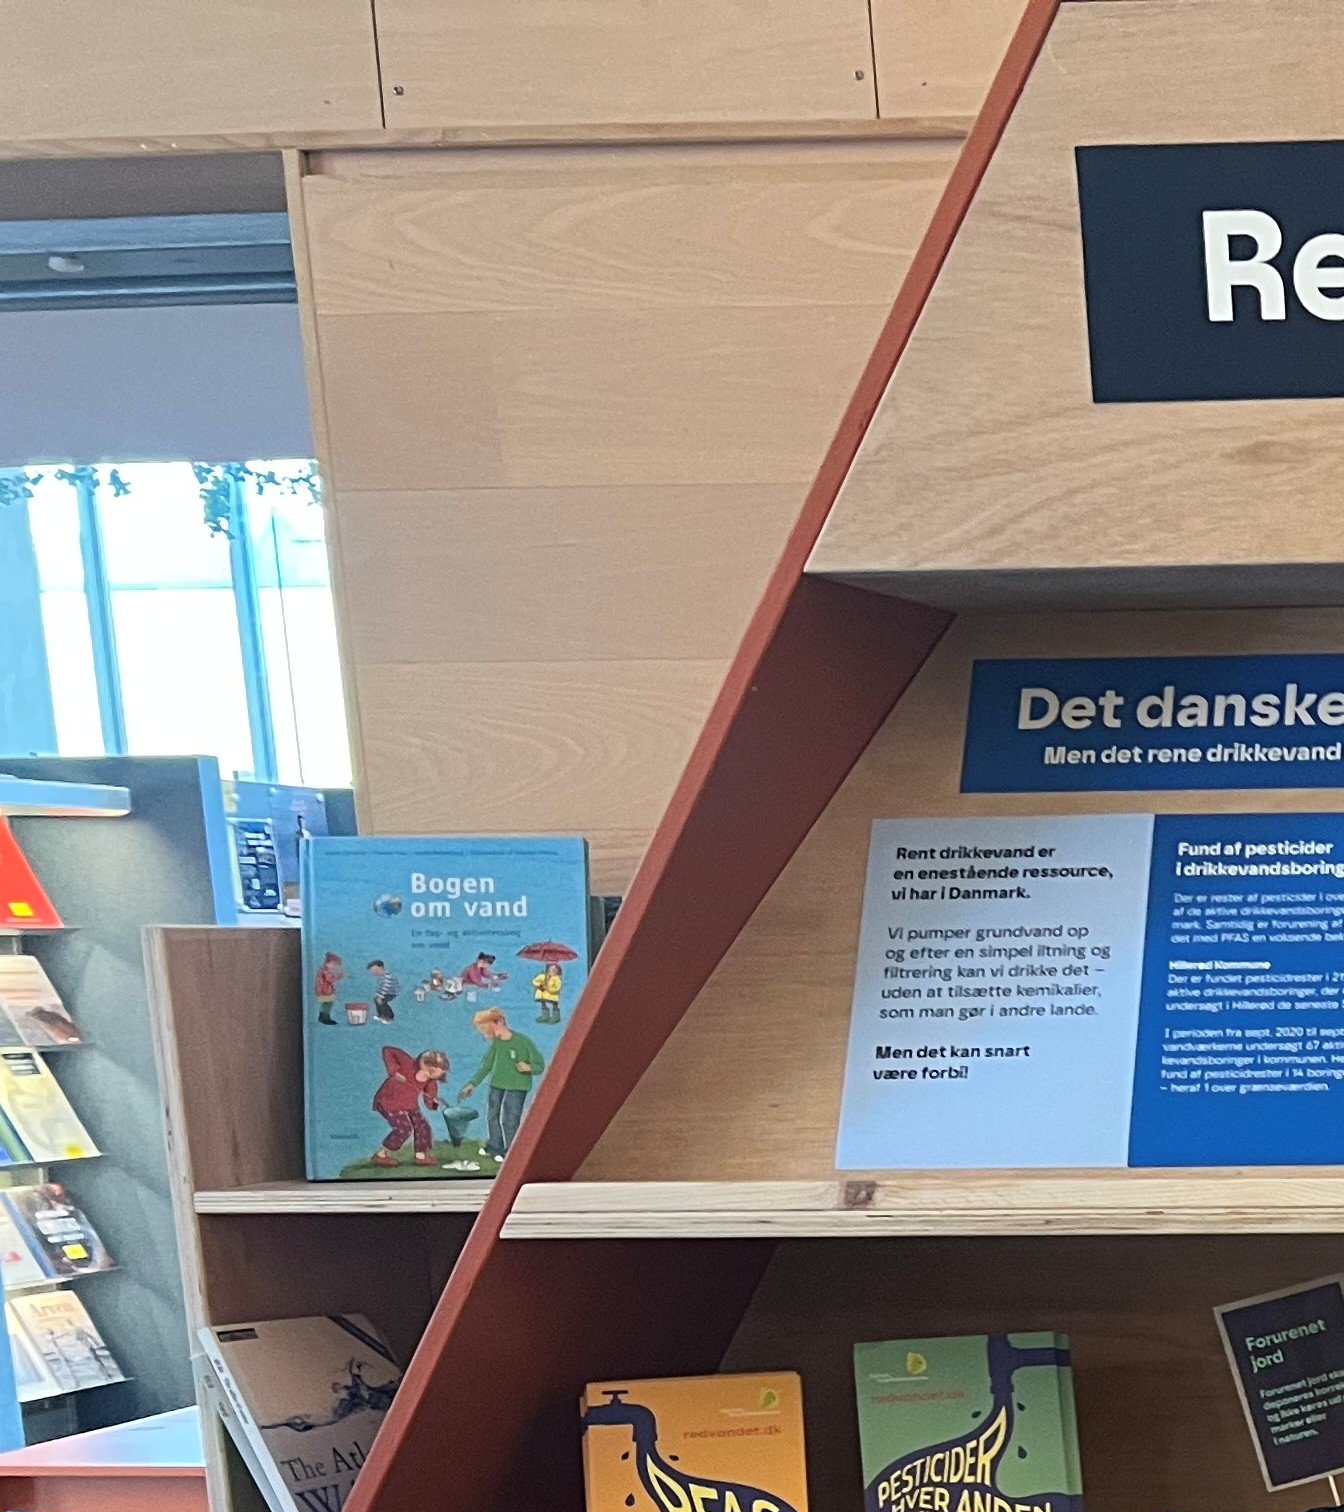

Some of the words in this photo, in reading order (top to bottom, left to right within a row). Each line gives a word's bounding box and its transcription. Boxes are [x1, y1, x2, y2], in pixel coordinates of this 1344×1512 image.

[1017, 688, 1125, 730] Det
[1043, 746, 1097, 765] Men
[1100, 745, 1144, 764] det
[1147, 747, 1203, 763] rene
[1206, 741, 1342, 763] drikkevand
[895, 846, 937, 860] Rent
[939, 845, 1035, 860] drikkevand
[1037, 847, 1056, 858] er
[1177, 841, 1222, 856] Fund
[1223, 841, 1242, 856] af
[1244, 840, 1334, 859] pesticider
[893, 869, 914, 881] en
[917, 864, 1020, 881] enestående
[1022, 866, 1114, 879] ressource,
[410, 872, 495, 900] Bogen
[891, 886, 907, 901] vi
[909, 887, 938, 901] har
[948, 886, 1031, 900] Danmark.
[410, 901, 451, 918] om
[463, 894, 528, 918] vand
[1245, 1319, 1326, 1352] Forurenet
[1249, 1348, 1286, 1374] jord
[279, 1457, 328, 1483] The
[332, 1441, 364, 1473] Atl
[877, 1405, 1007, 1508] PESTICIDER
